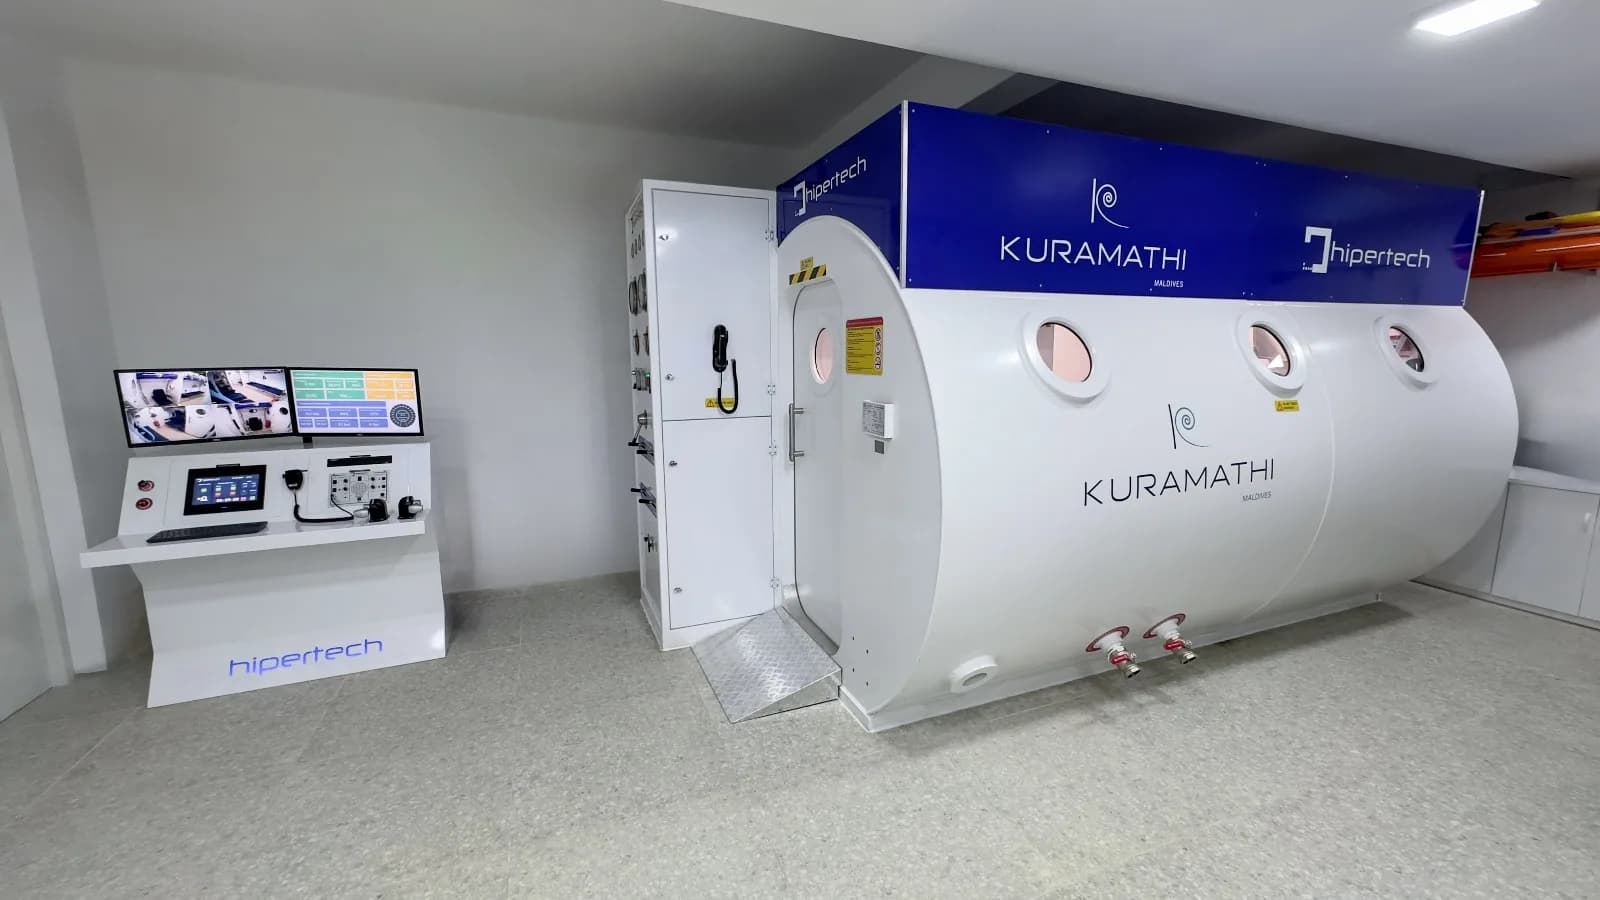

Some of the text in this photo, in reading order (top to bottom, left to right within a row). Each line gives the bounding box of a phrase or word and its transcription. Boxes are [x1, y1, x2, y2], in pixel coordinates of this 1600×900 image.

[806, 156, 867, 203] hipertech
[1000, 235, 1187, 271] KURAMATHI
[1330, 241, 1431, 269] hipertech
[1154, 279, 1184, 288] MALDIVES
[1083, 458, 1274, 507] KURAMATHI
[1242, 490, 1272, 502] MALDIVES
[229, 638, 383, 677] hipertech
